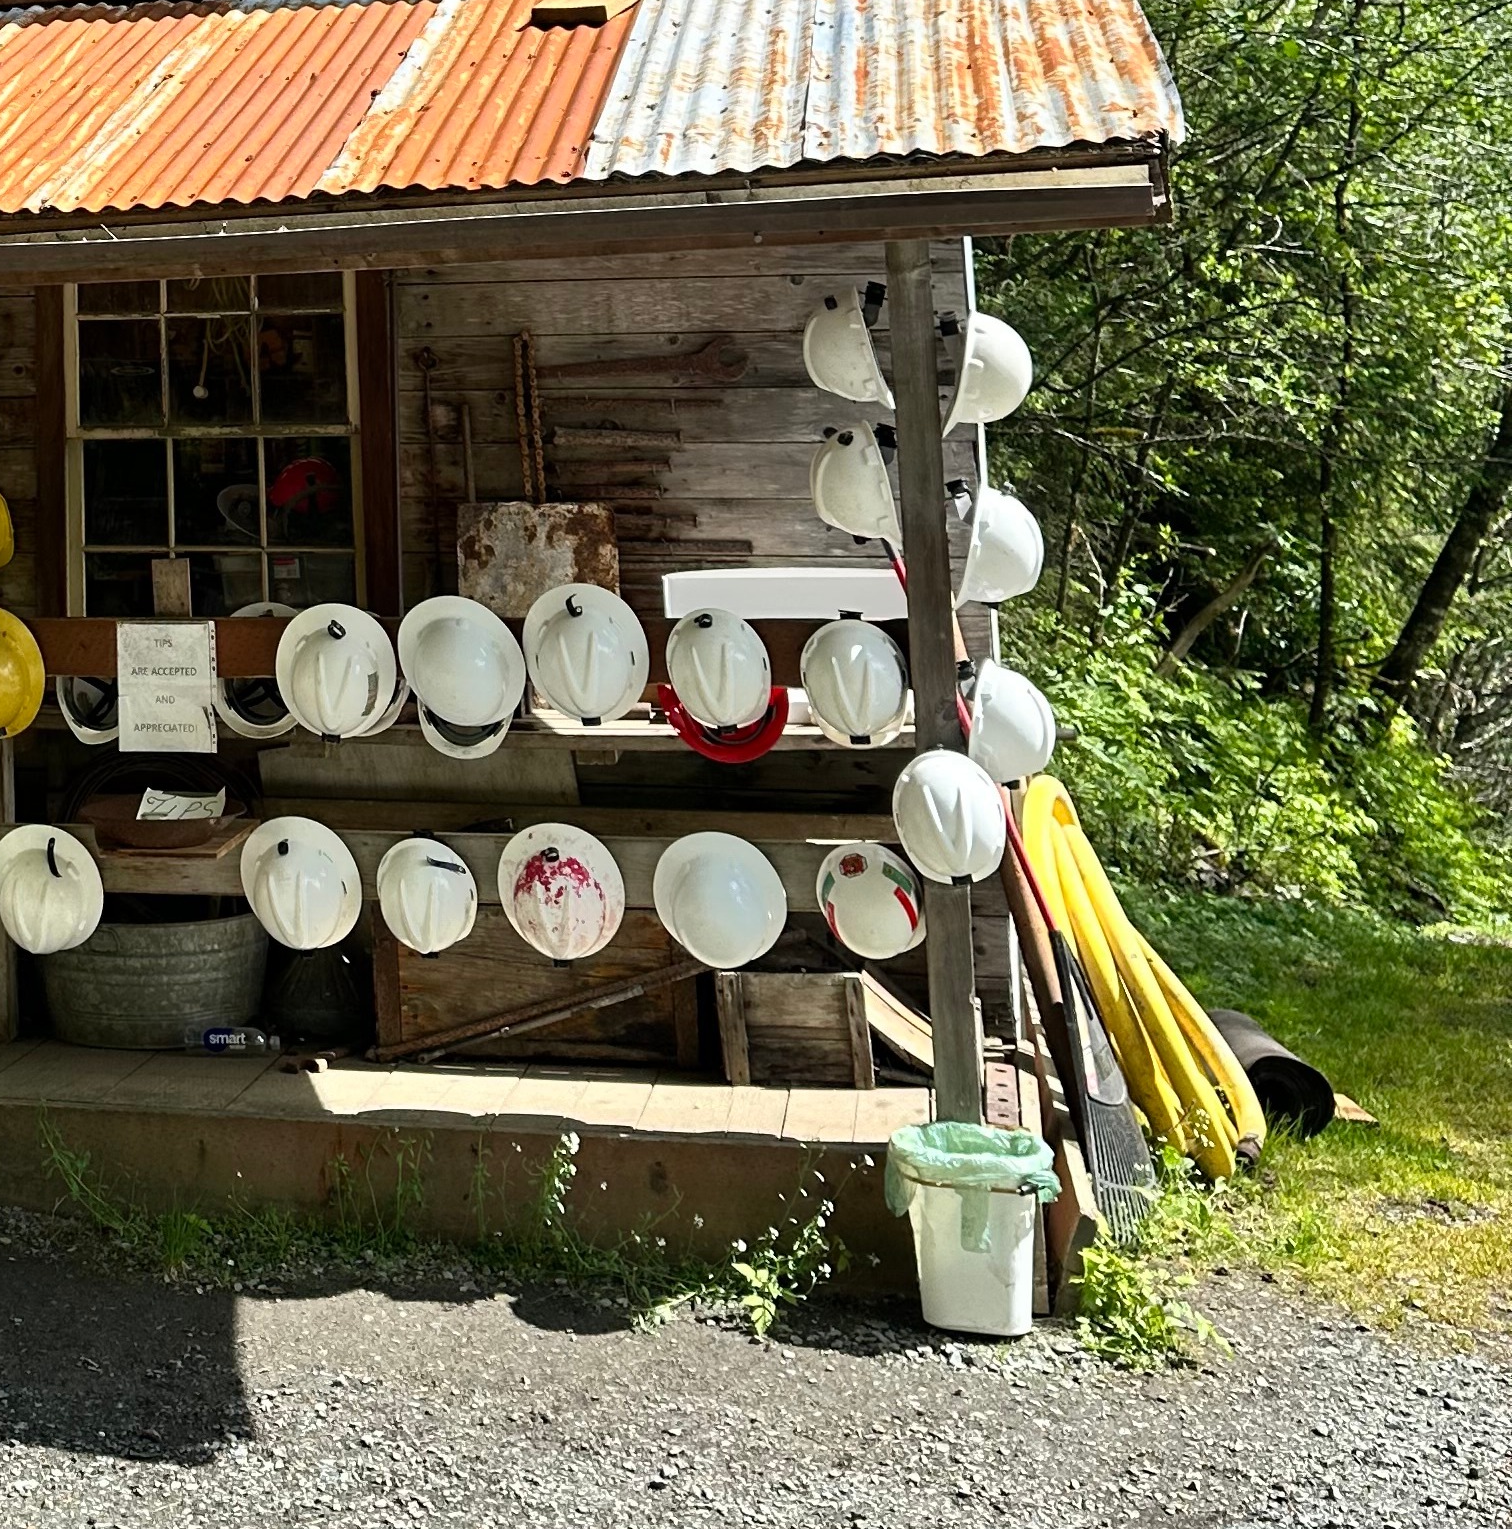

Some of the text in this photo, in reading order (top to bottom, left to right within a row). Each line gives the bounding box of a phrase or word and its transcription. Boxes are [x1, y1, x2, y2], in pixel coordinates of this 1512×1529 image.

[153, 638, 173, 648] TIPS
[131, 666, 197, 677] ARE ACCEPTED
[155, 695, 176, 704] AND
[208, 1032, 246, 1045] smart
